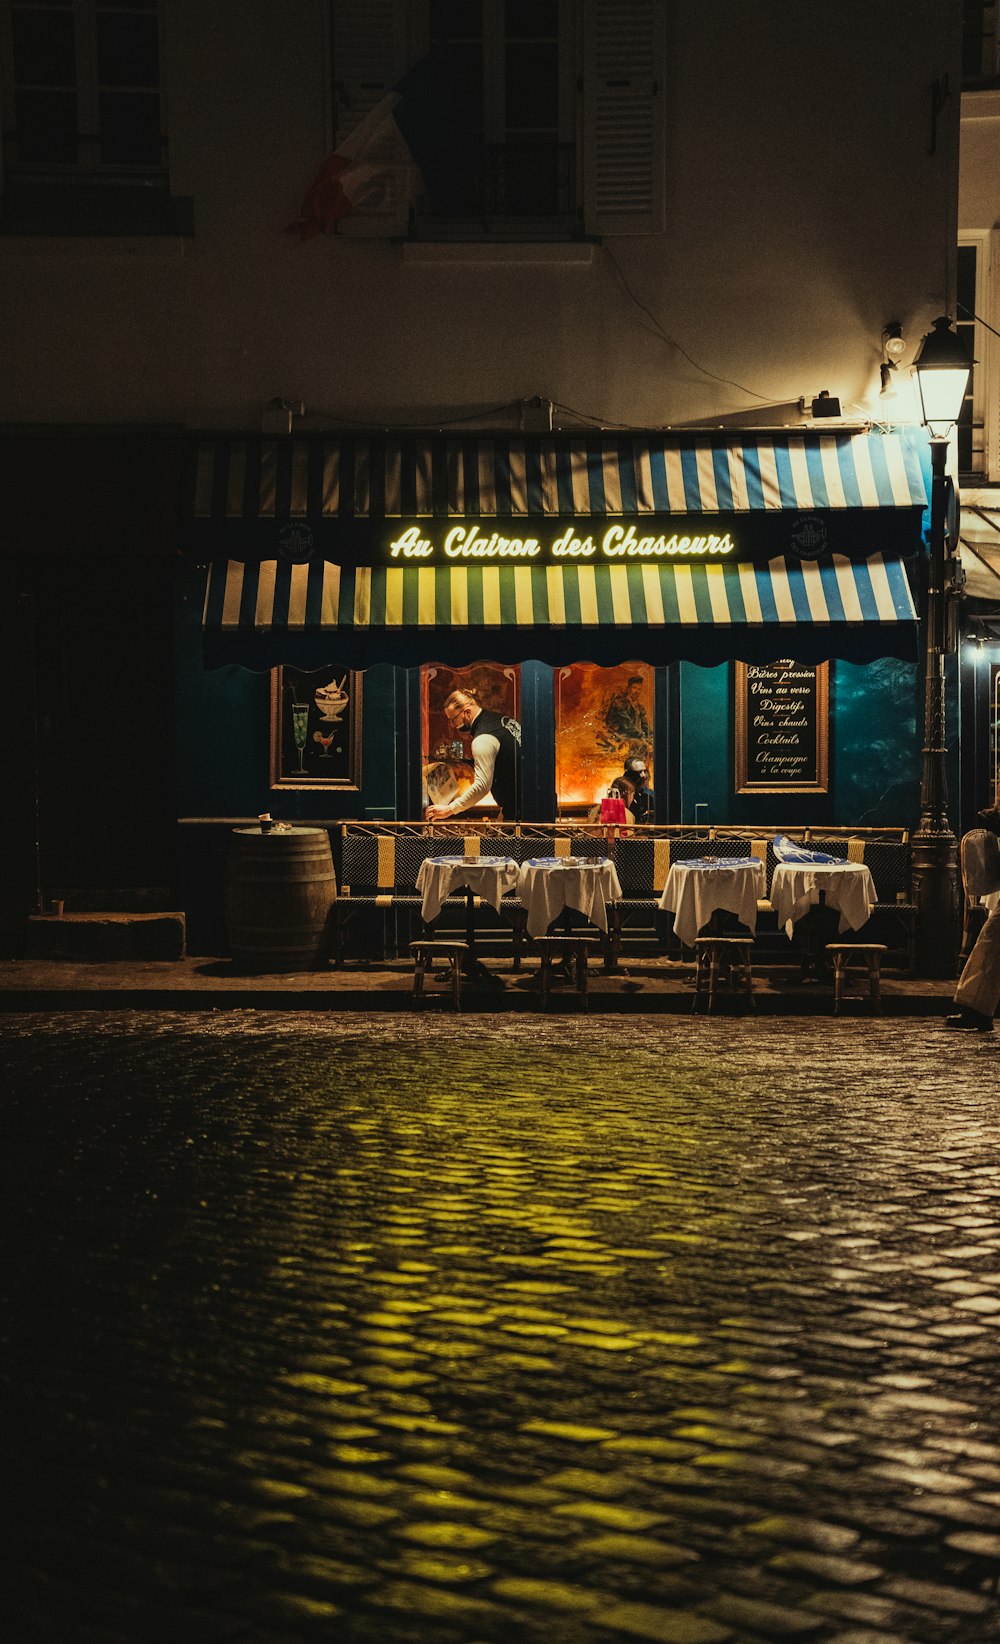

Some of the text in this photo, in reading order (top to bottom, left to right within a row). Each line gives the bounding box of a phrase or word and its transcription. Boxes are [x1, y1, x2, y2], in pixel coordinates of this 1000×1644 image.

[390, 525, 734, 557] Au Clairon des Chasseurs
[779, 670, 815, 682] pression
[751, 682, 773, 694] Vins
[760, 699, 805, 714] Digestifs
[753, 715, 808, 727] Vins chauds
[756, 733, 800, 744] Cocktails
[755, 751, 808, 766] Champagne
[770, 765, 779, 773] la
[780, 768, 802, 777] coupe
